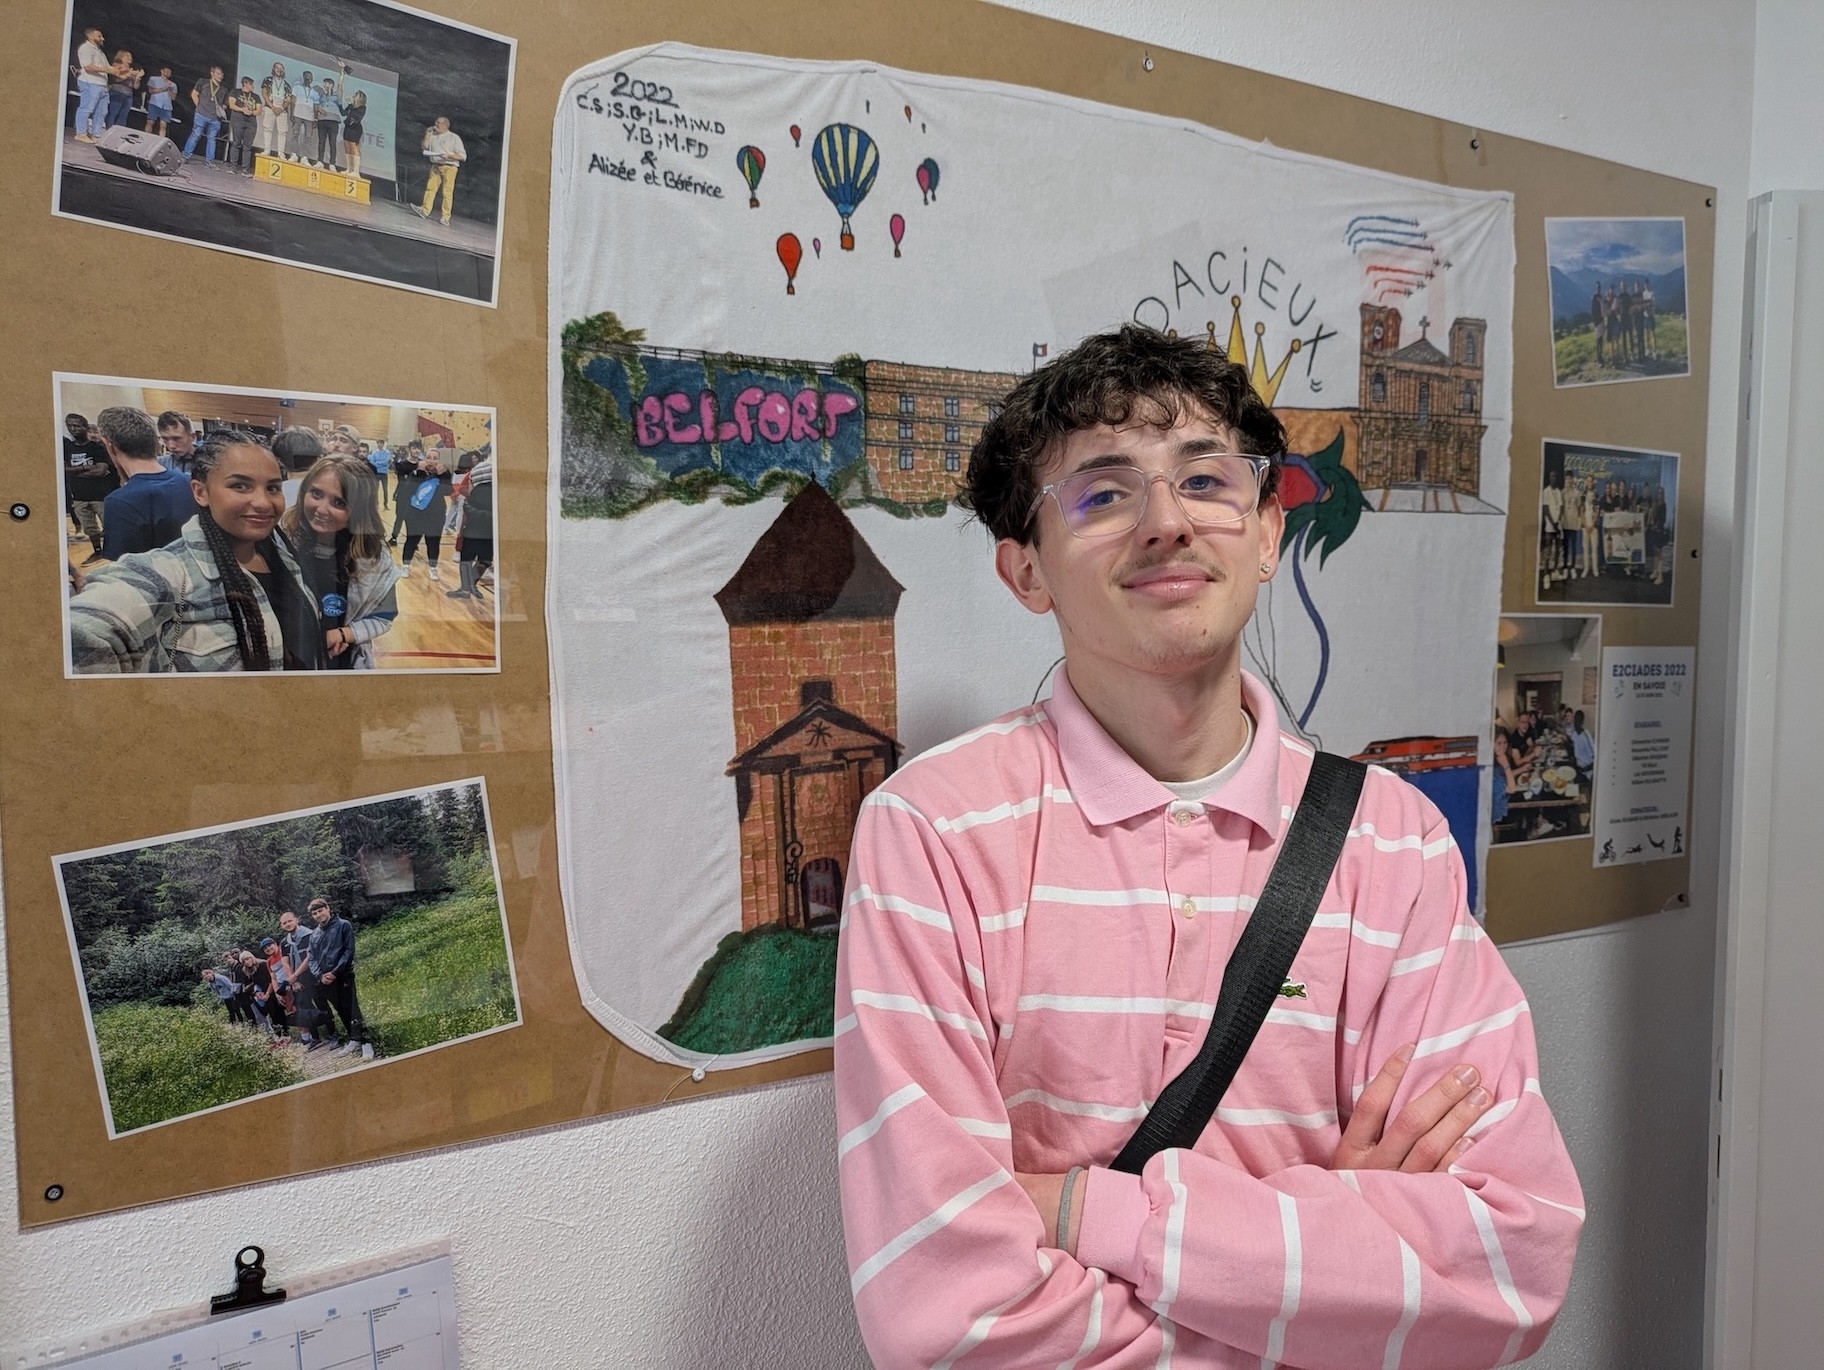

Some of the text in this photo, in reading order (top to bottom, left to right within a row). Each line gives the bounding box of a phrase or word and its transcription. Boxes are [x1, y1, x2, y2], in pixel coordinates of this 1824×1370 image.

[610, 71, 680, 108] 2022
[271, 163, 280, 177] 2
[588, 153, 637, 182] Alizée
[643, 170, 662, 187] et
[348, 181, 355, 193] 3
[632, 385, 858, 448] BELFORT
[1612, 663, 1686, 677] E2CIADES 2022
